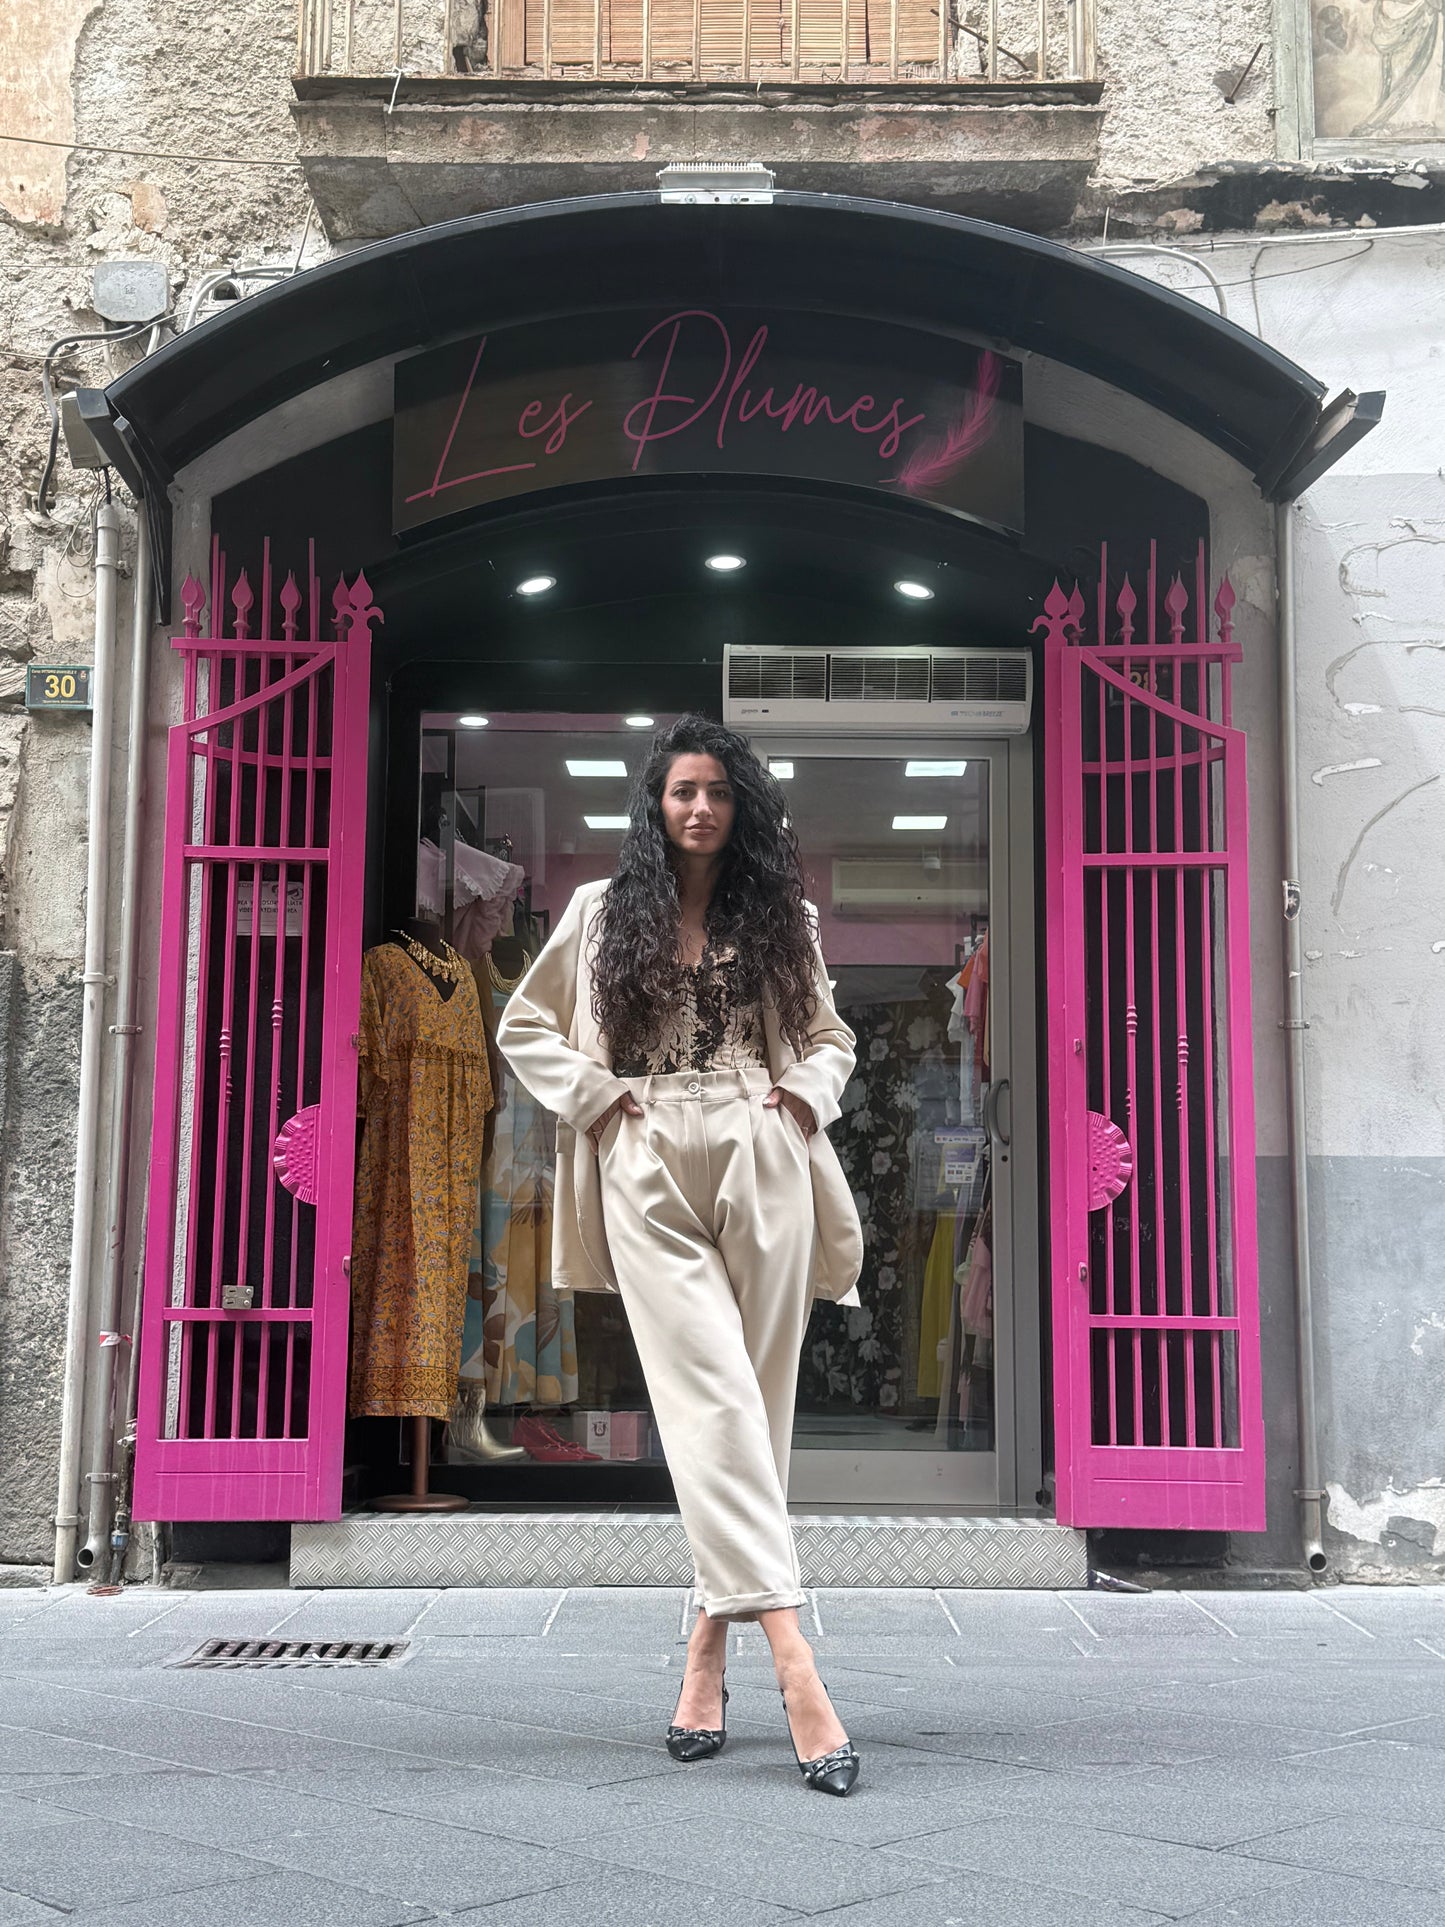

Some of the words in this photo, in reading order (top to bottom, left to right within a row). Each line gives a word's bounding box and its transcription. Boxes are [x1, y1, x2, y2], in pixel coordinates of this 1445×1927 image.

[405, 335, 593, 503] Les
[622, 309, 926, 473] Plumes
[45, 674, 76, 698] 30
